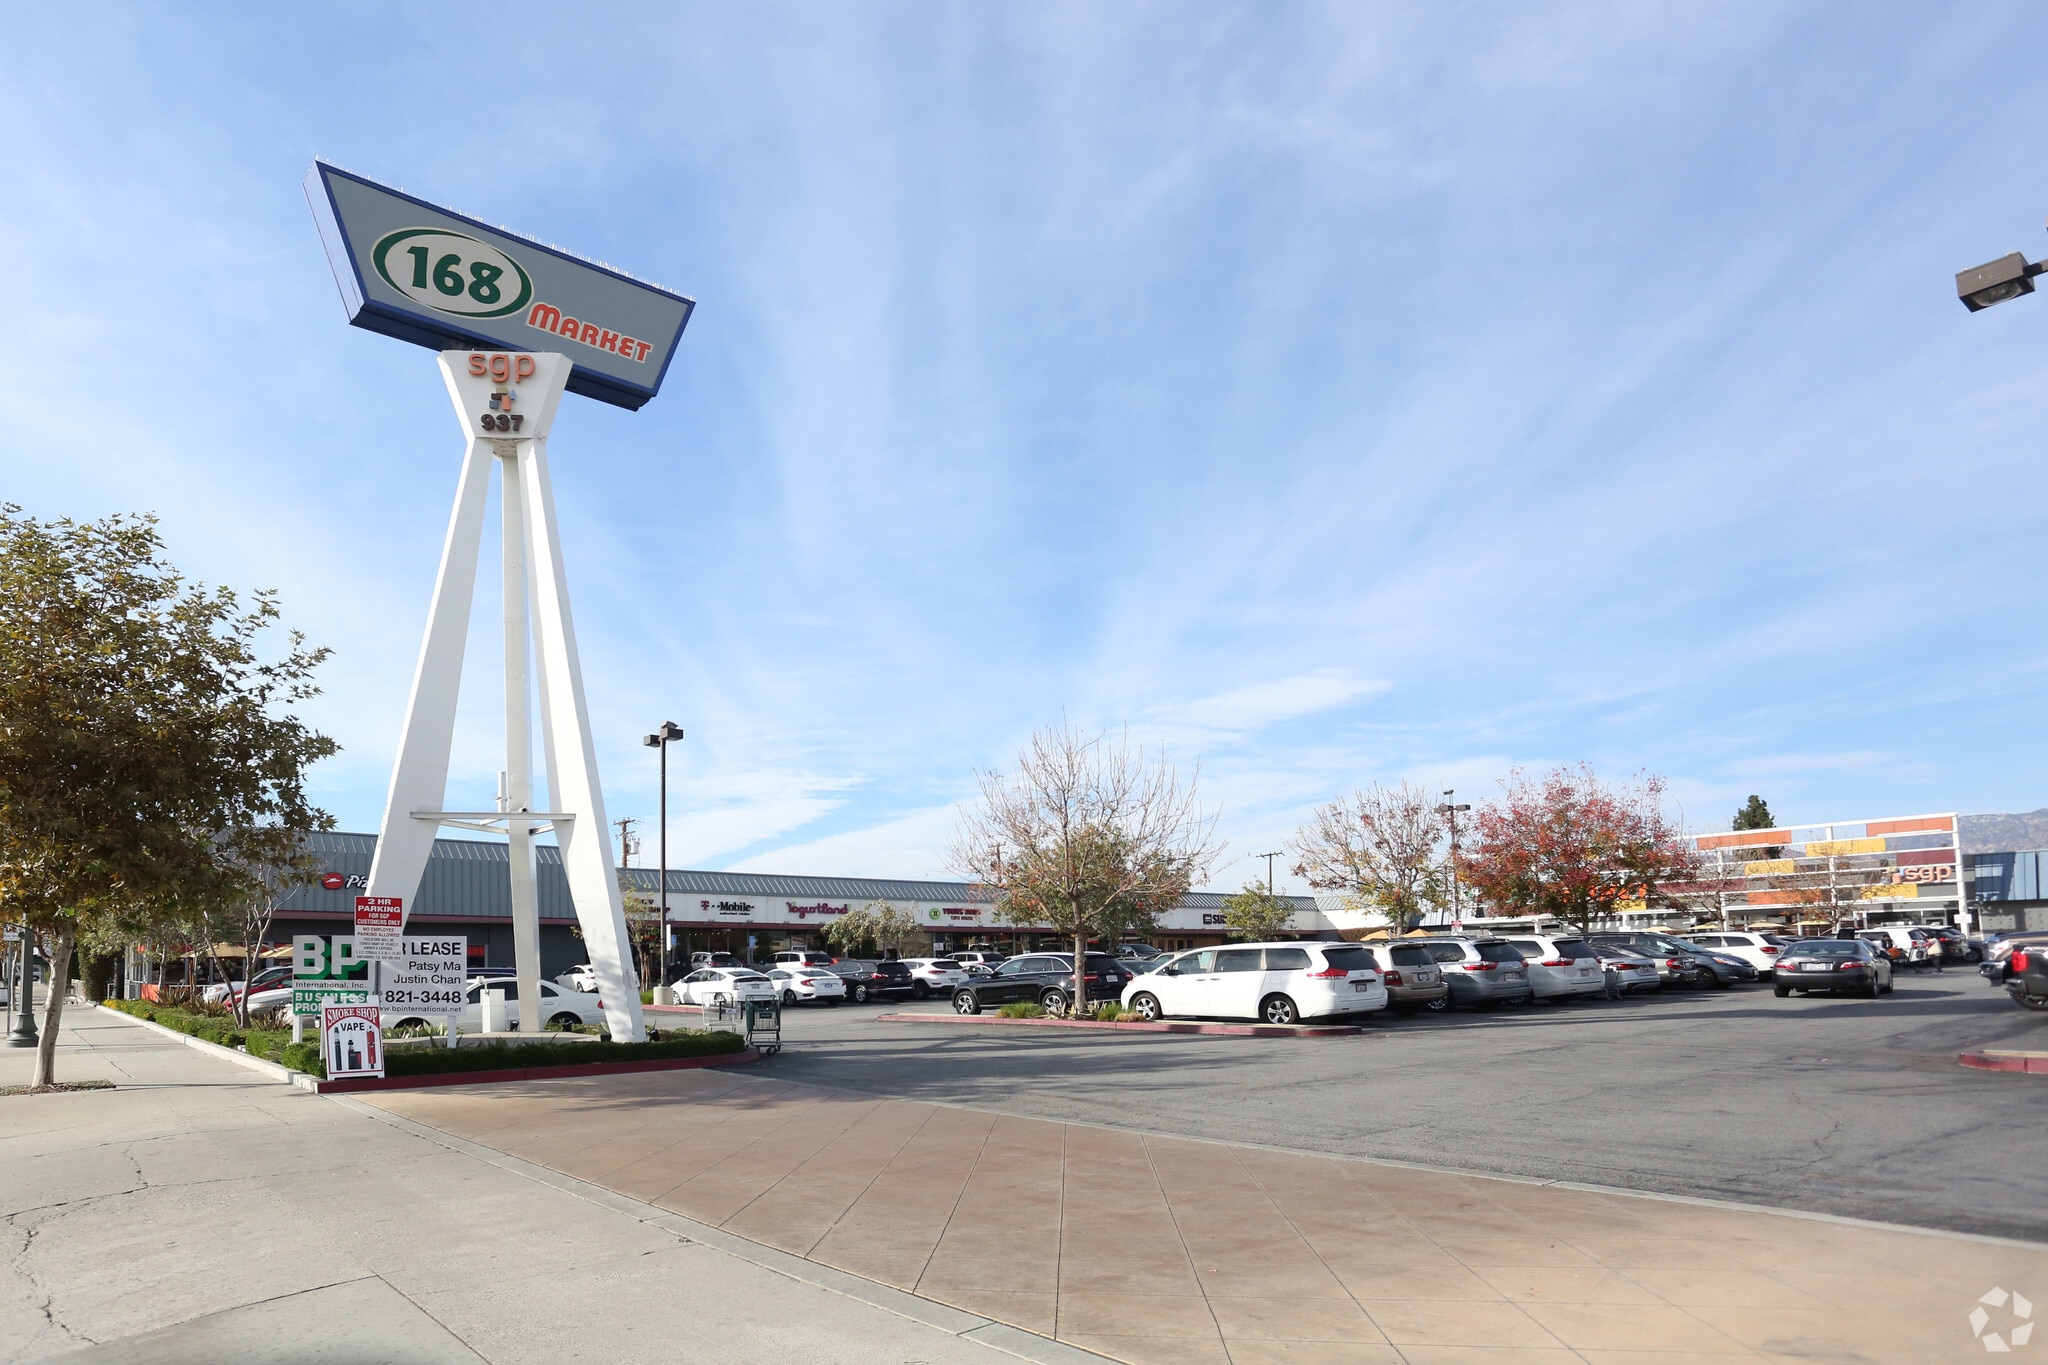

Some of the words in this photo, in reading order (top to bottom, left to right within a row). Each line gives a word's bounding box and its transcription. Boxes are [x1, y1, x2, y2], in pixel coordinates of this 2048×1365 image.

[406, 246, 504, 304] 168
[528, 303, 652, 362] MARKET
[468, 353, 536, 384] sgp
[480, 413, 524, 432] 937
[1904, 865, 1952, 884] sgp
[357, 905, 401, 913] PARKING
[785, 901, 849, 919] Yogurtland
[293, 935, 356, 974] BP
[411, 942, 462, 956] LEASE
[408, 961, 440, 973] Patsy
[443, 961, 461, 971] Ma
[295, 981, 349, 989] International,
[393, 974, 428, 985] Justin
[430, 974, 461, 985] Chan
[385, 990, 462, 1004] 821-3448
[326, 1008, 355, 1026] SMOKE
[356, 1007, 378, 1023] SHOP
[340, 1022, 365, 1031] VAPE
